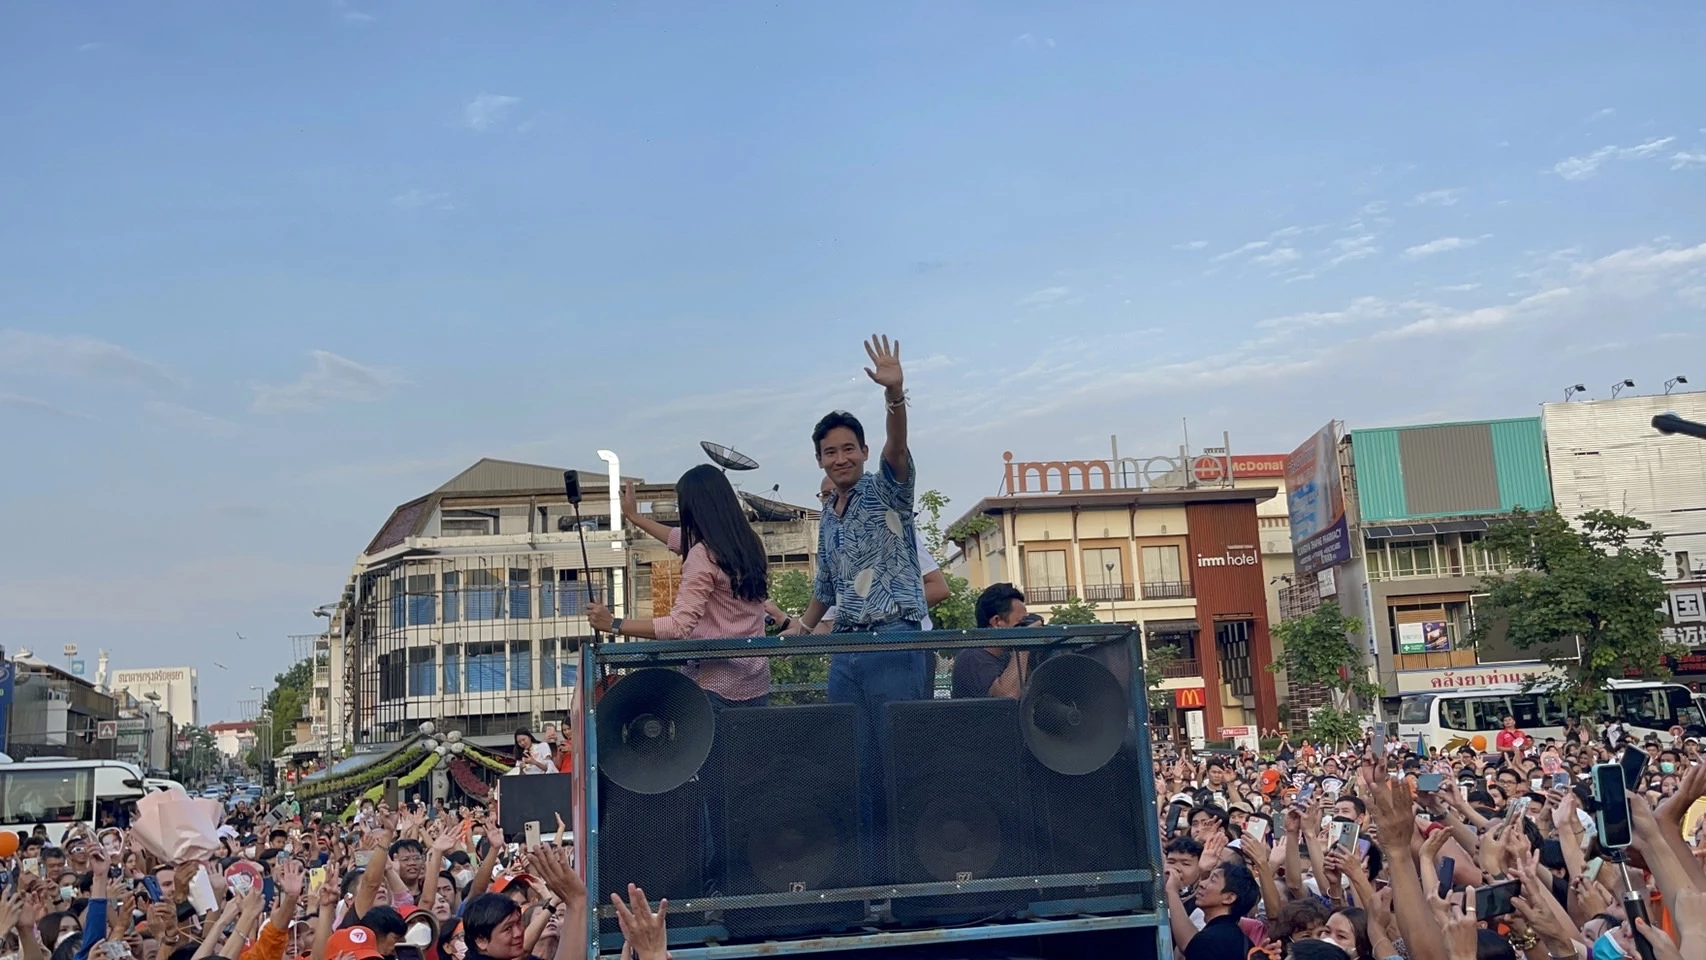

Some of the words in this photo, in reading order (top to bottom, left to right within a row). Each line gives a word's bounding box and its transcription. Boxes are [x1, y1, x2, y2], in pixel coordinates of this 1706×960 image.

[1003, 451, 1111, 493] imm
[1111, 431, 1234, 489] hotel
[1197, 553, 1225, 567] imm
[1226, 549, 1258, 566] hotel
